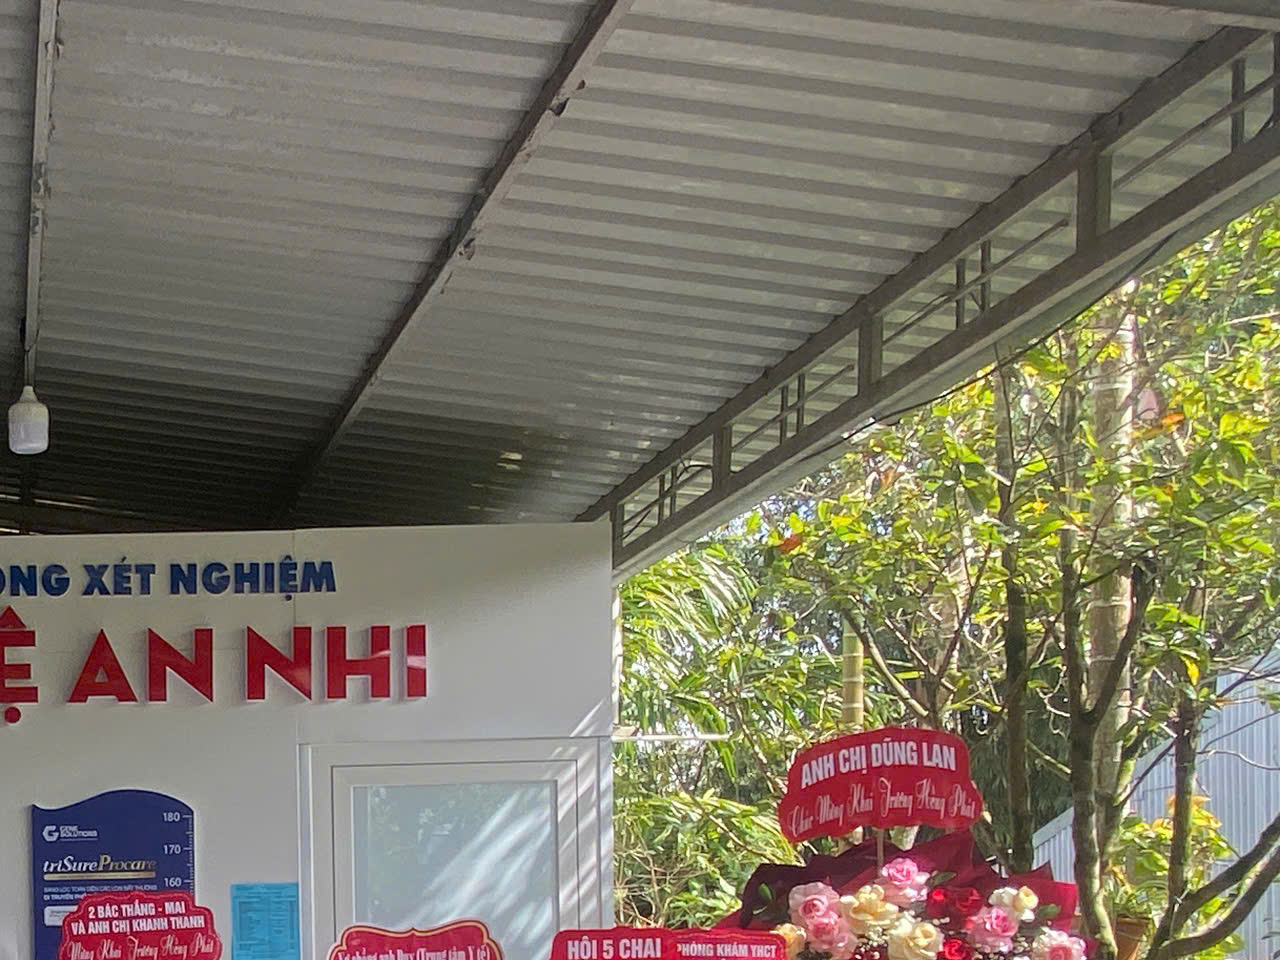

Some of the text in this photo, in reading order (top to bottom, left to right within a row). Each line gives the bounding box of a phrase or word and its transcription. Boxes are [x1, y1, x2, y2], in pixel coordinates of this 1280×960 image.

[81, 557, 157, 595] XÉT
[170, 555, 337, 601] NGHIỆM
[68, 628, 214, 703] AN
[246, 624, 427, 701] NHI
[801, 737, 957, 789] ANH CHỊ DŨNG LAN
[163, 812, 181, 822] 180
[163, 845, 181, 855] 170
[163, 877, 182, 887] 160
[88, 907, 96, 919] 2
[97, 904, 119, 919] BÁC
[165, 901, 186, 914] MAI
[72, 915, 205, 935] VÀ ANH CHỊ KHANH THANH
[602, 941, 614, 959] 5
[619, 937, 662, 959] CHAI
[717, 941, 748, 957] KHÁM
